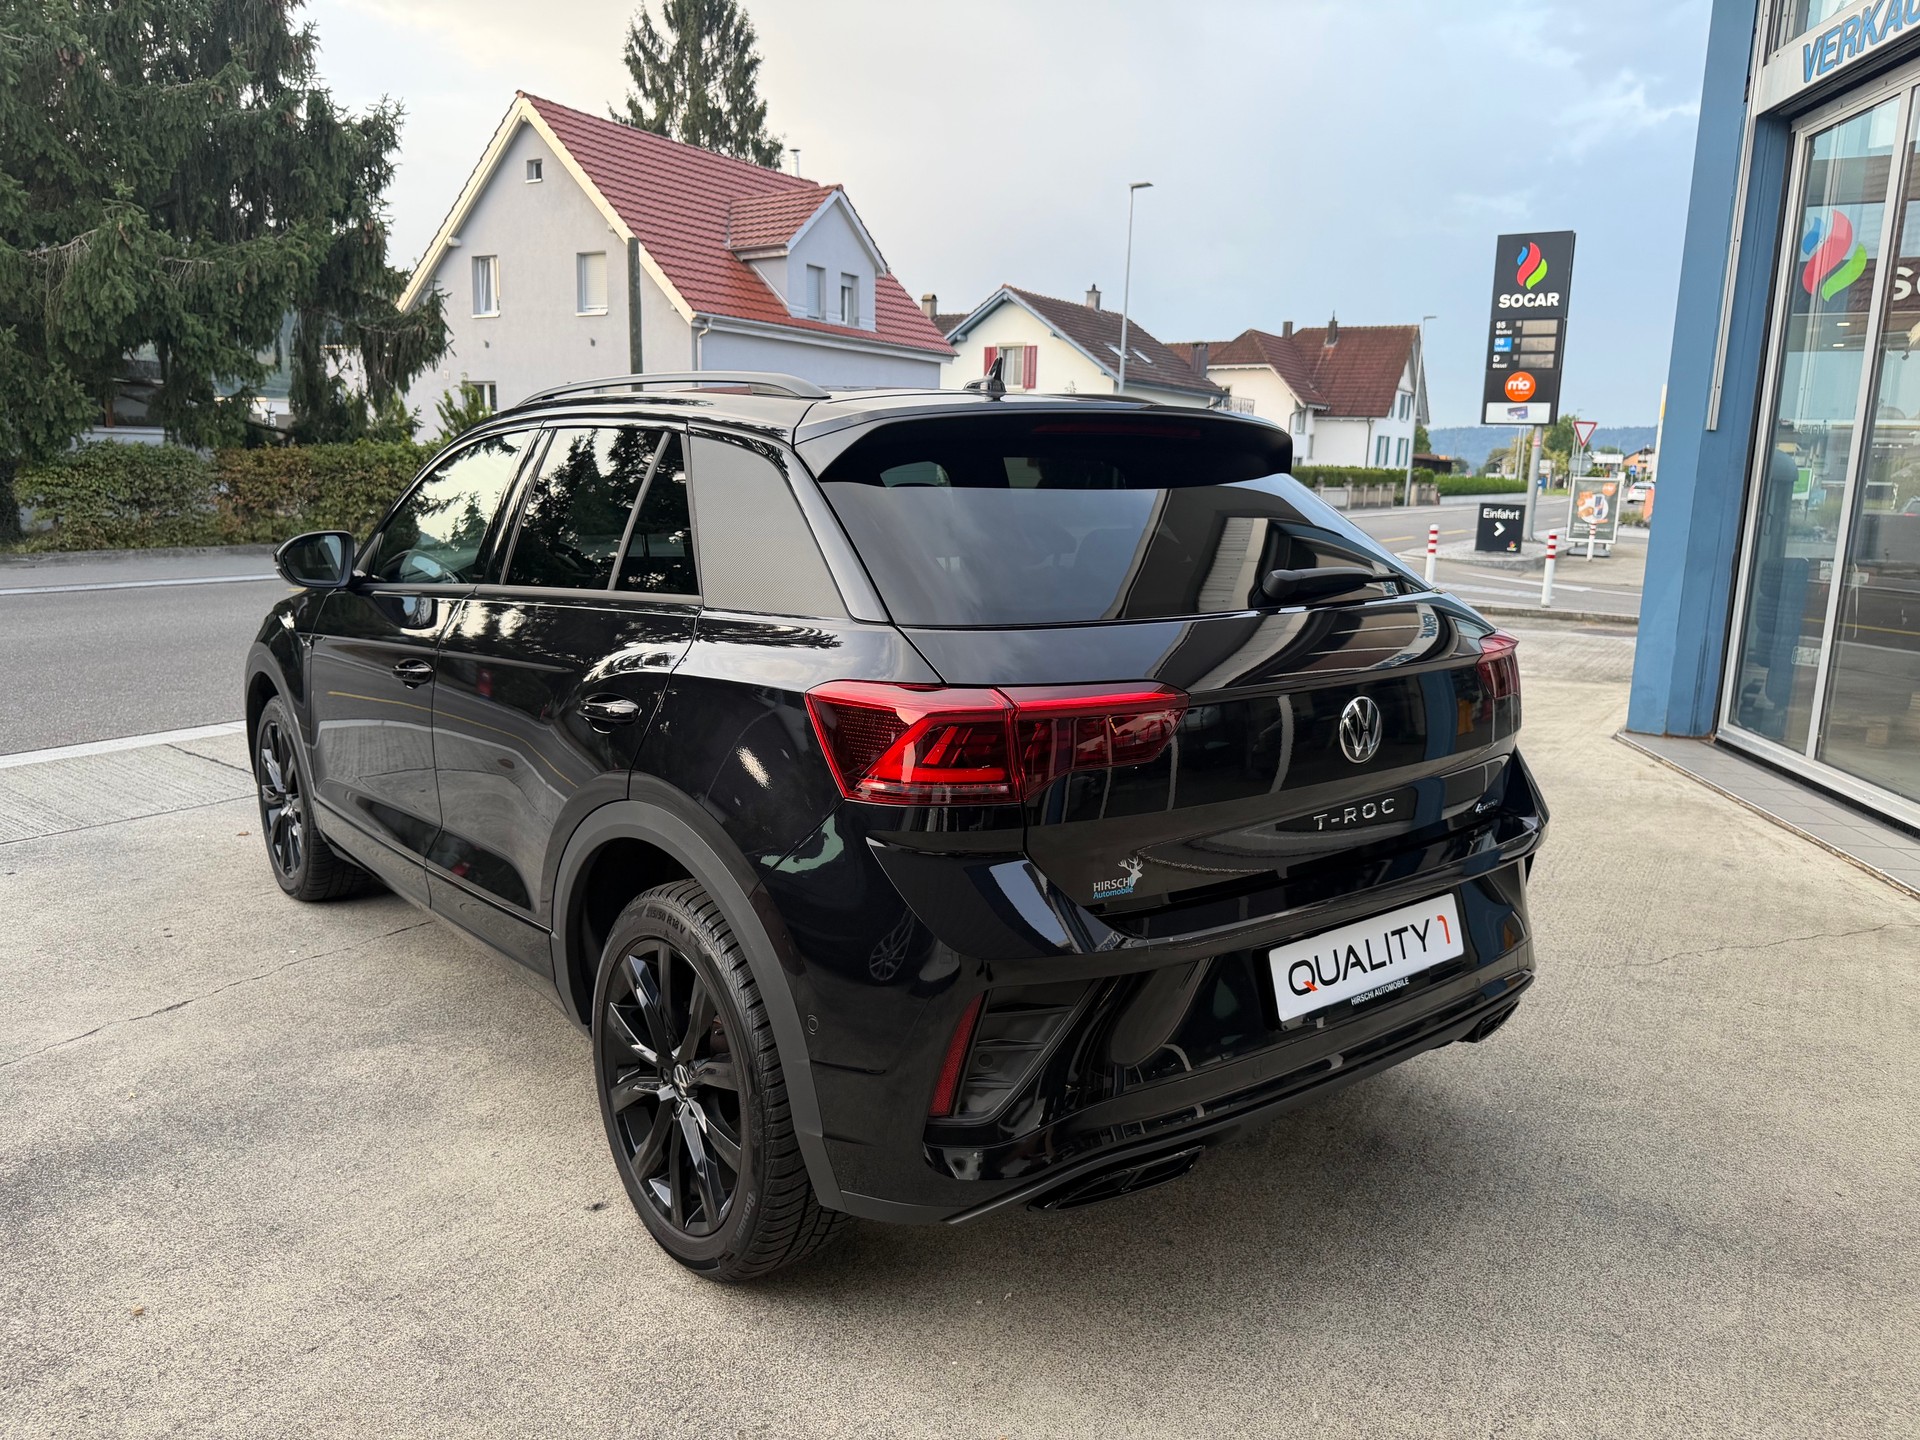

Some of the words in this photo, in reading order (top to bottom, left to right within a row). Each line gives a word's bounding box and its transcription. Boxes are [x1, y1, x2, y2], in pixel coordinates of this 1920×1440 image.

[1498, 292, 1560, 309] SOCAR
[1483, 507, 1520, 520] Einfahrt
[1313, 798, 1395, 830] T-ROC
[1093, 885, 1134, 899] Automobile
[1288, 918, 1430, 996] QUALITY
[1436, 914, 1451, 944] 1
[1350, 990, 1375, 1006] HIRSCHI
[1374, 976, 1410, 997] AUTOMOBILE
